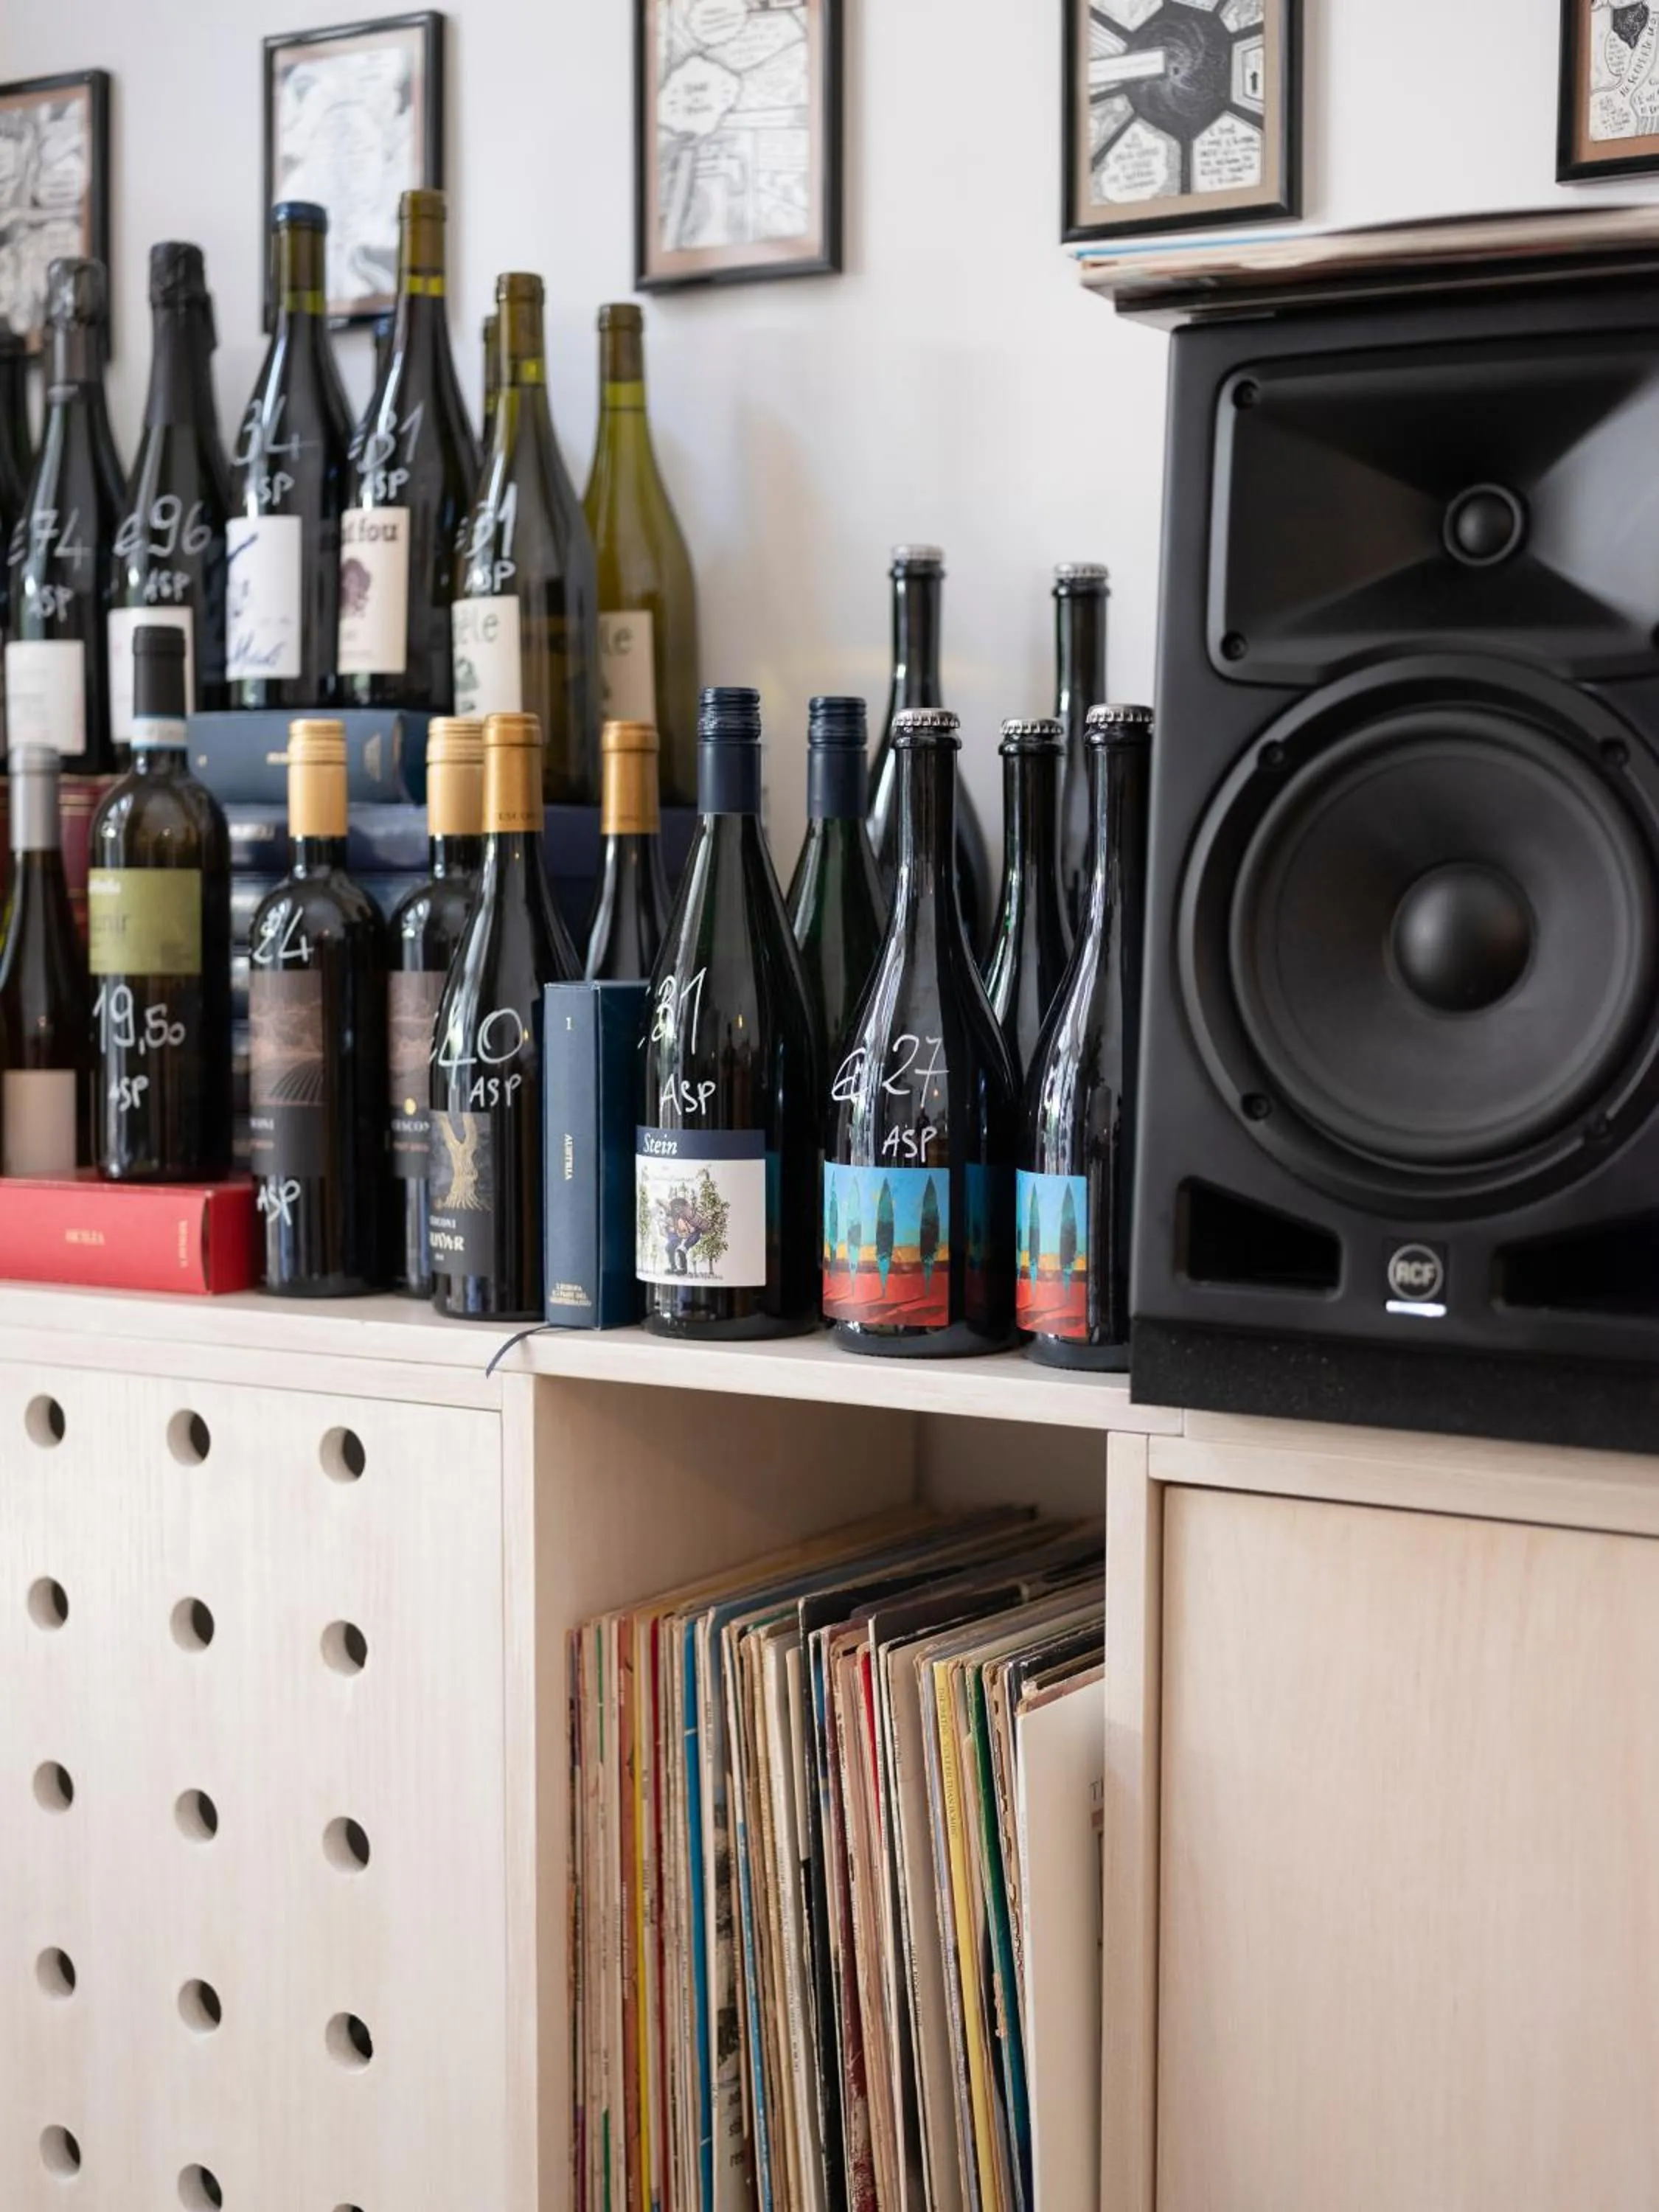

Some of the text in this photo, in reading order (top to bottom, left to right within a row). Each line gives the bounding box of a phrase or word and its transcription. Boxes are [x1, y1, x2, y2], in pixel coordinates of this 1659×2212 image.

[92, 983, 186, 1057] 19,50
[469, 1073, 523, 1108] ASP
[659, 1073, 716, 1116] ASP
[643, 1133, 678, 1155] Stein
[881, 1124, 937, 1164] ASP
[1396, 1259, 1435, 1287] RCF
